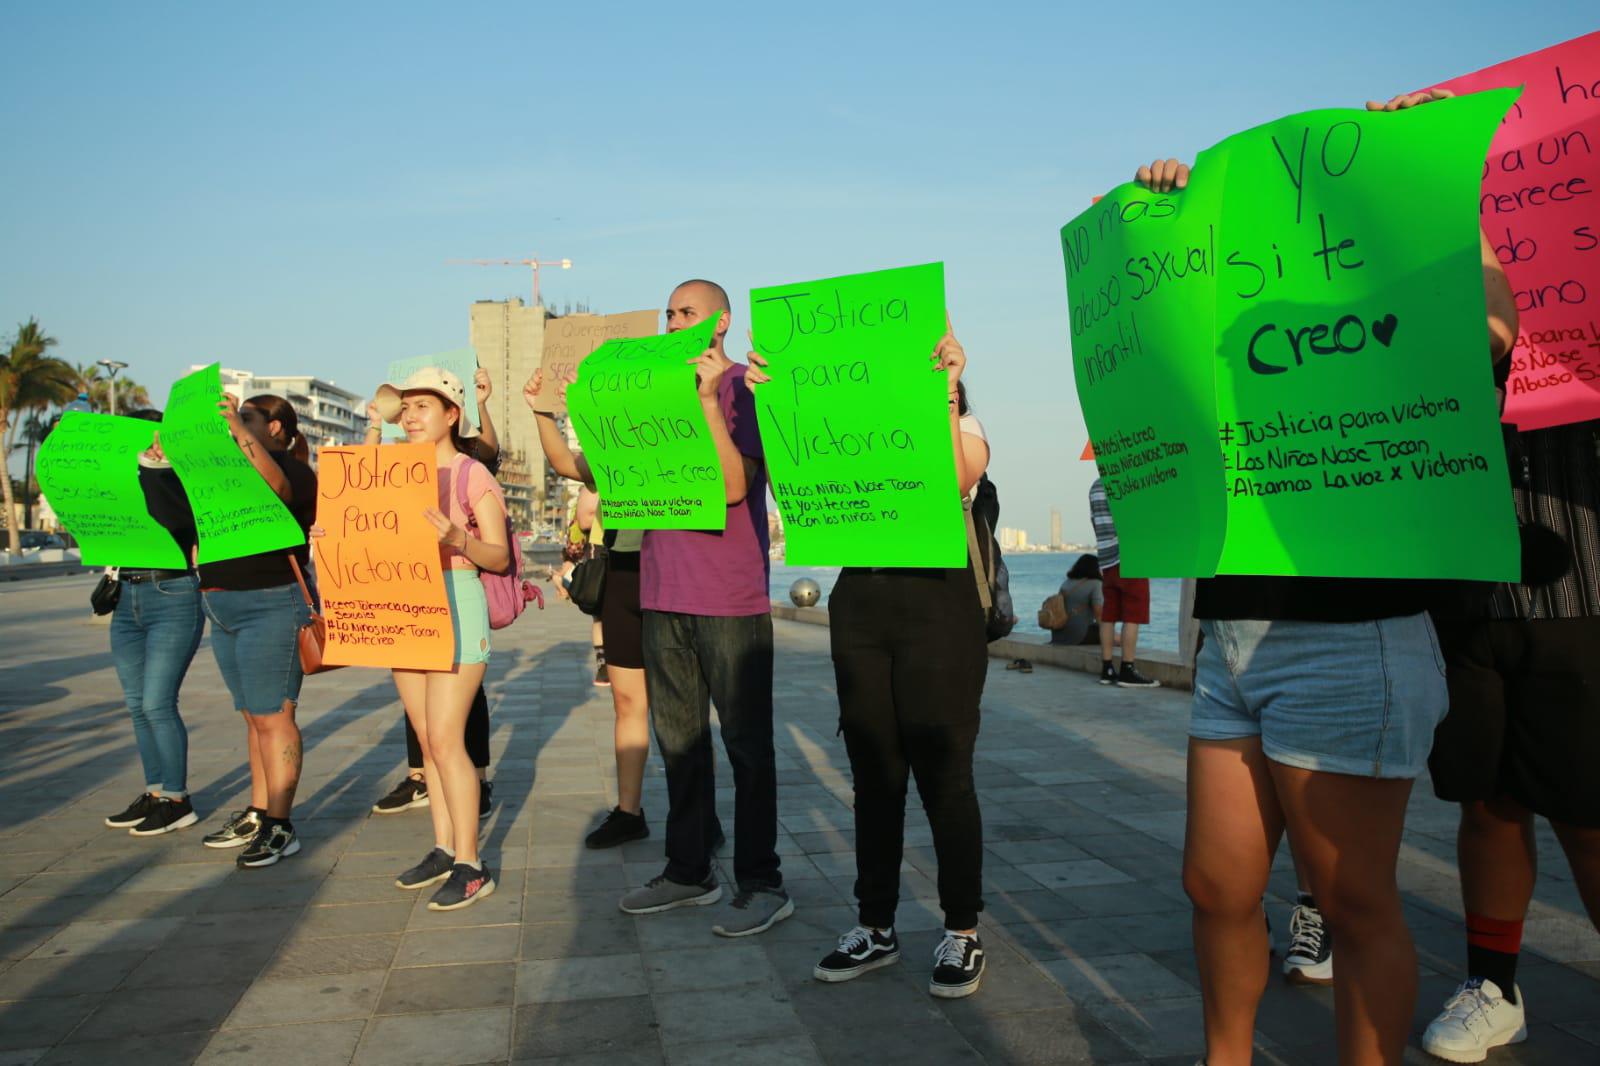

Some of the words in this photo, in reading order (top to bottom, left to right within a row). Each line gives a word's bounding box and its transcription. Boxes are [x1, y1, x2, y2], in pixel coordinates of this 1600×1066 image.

[1501, 150, 1525, 172] a
[1537, 131, 1591, 165] un
[1098, 198, 1176, 241] mas
[1312, 213, 1364, 281] te
[561, 321, 629, 338] Queremos
[755, 288, 909, 354] Justicia
[1247, 314, 1366, 375] Creo
[589, 368, 653, 407] para
[792, 361, 870, 405] para
[1512, 373, 1573, 395] Abuso
[767, 404, 915, 467] Victoria
[1219, 411, 1333, 446] #Justicia
[1339, 410, 1389, 438] para
[1364, 440, 1429, 461] Tocan
[321, 448, 429, 500] Justicia
[597, 463, 625, 494] Yo
[778, 482, 814, 497] #Los
[885, 478, 926, 492] Tocan
[1227, 478, 1312, 498] Alzamos
[1411, 451, 1488, 481] Victoria
[881, 509, 899, 521] no
[317, 540, 432, 590] Victoria
[405, 624, 441, 639] Tocan
